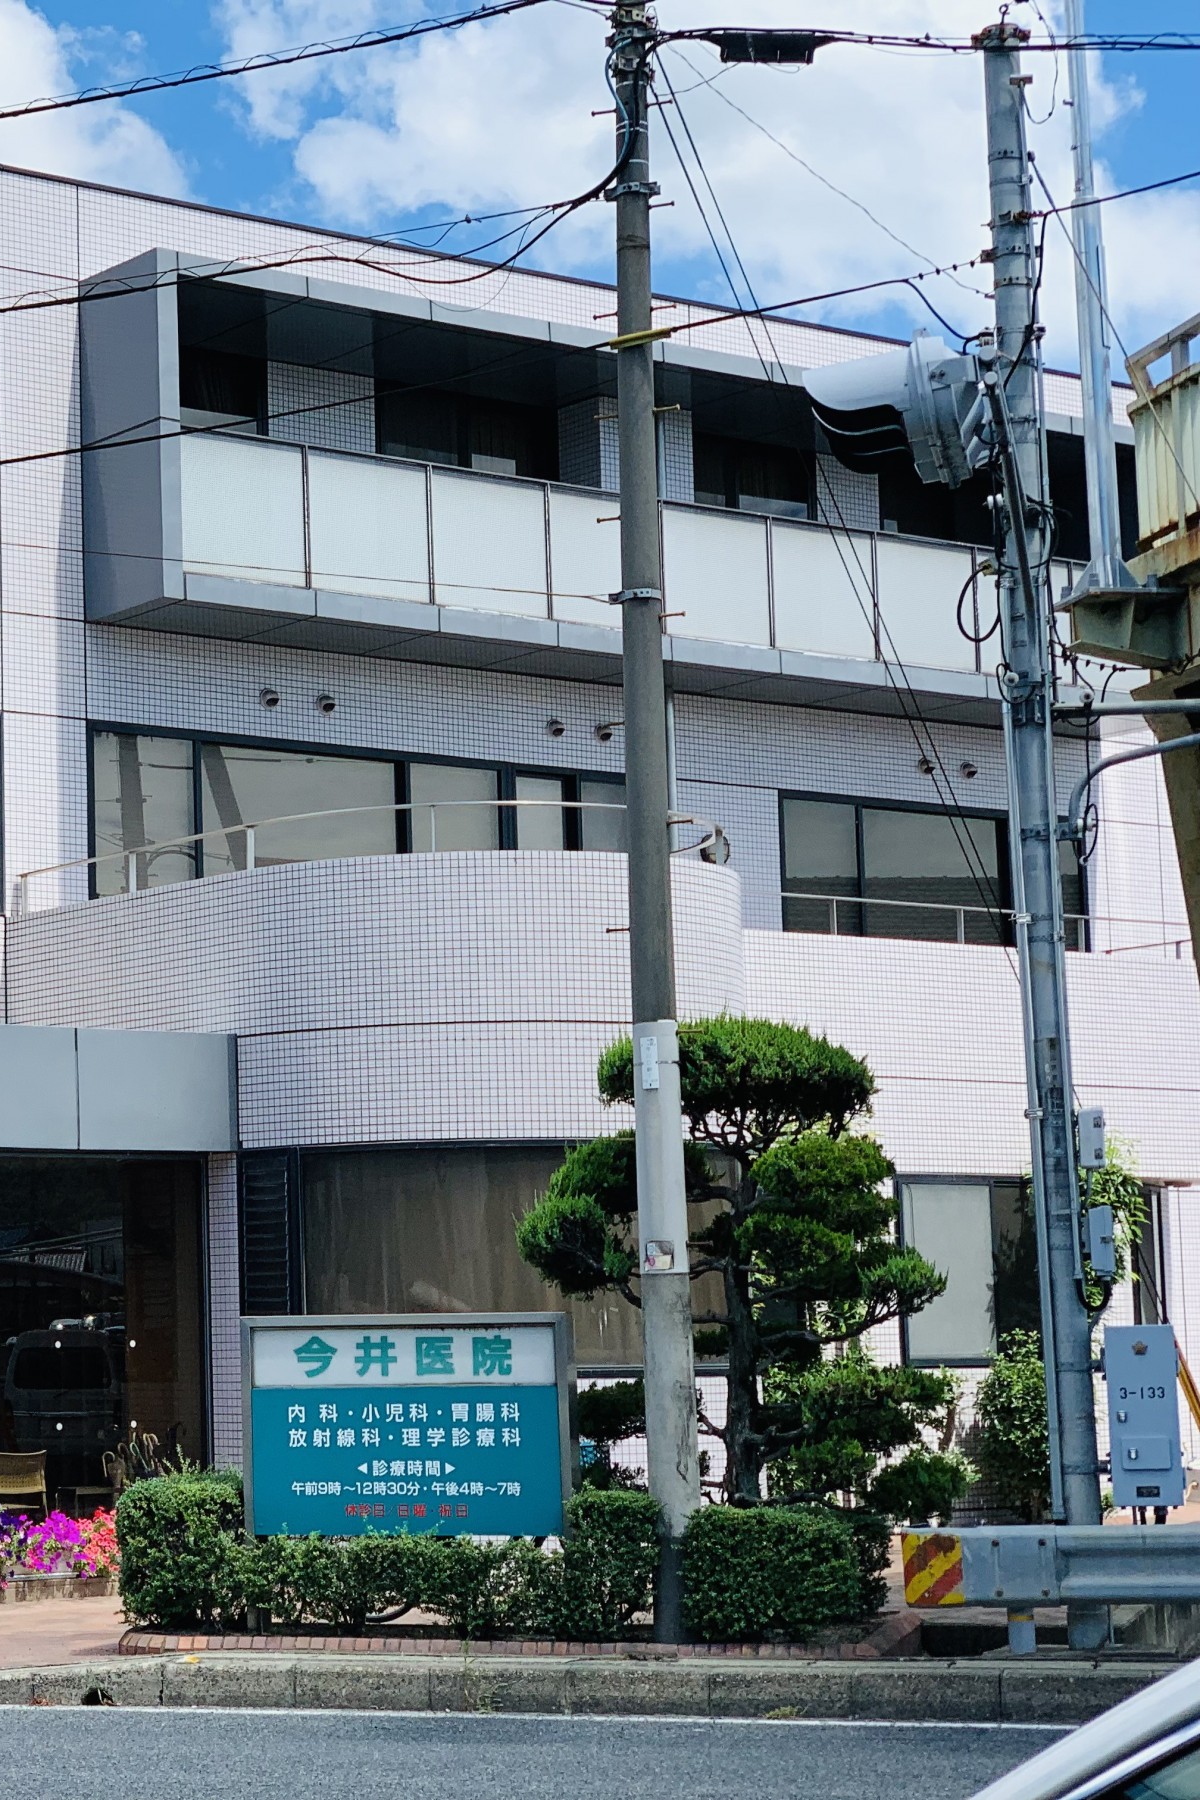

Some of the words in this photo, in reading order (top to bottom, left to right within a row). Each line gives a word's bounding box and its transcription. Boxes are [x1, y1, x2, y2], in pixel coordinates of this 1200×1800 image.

[293, 1335, 512, 1377] 今井医院
[1120, 1386, 1165, 1400] 3-133
[287, 1402, 520, 1423] 内科・小児科・胃腸科
[288, 1427, 521, 1447] 放射線科・理学診療科
[372, 1460, 441, 1476] 診療時間
